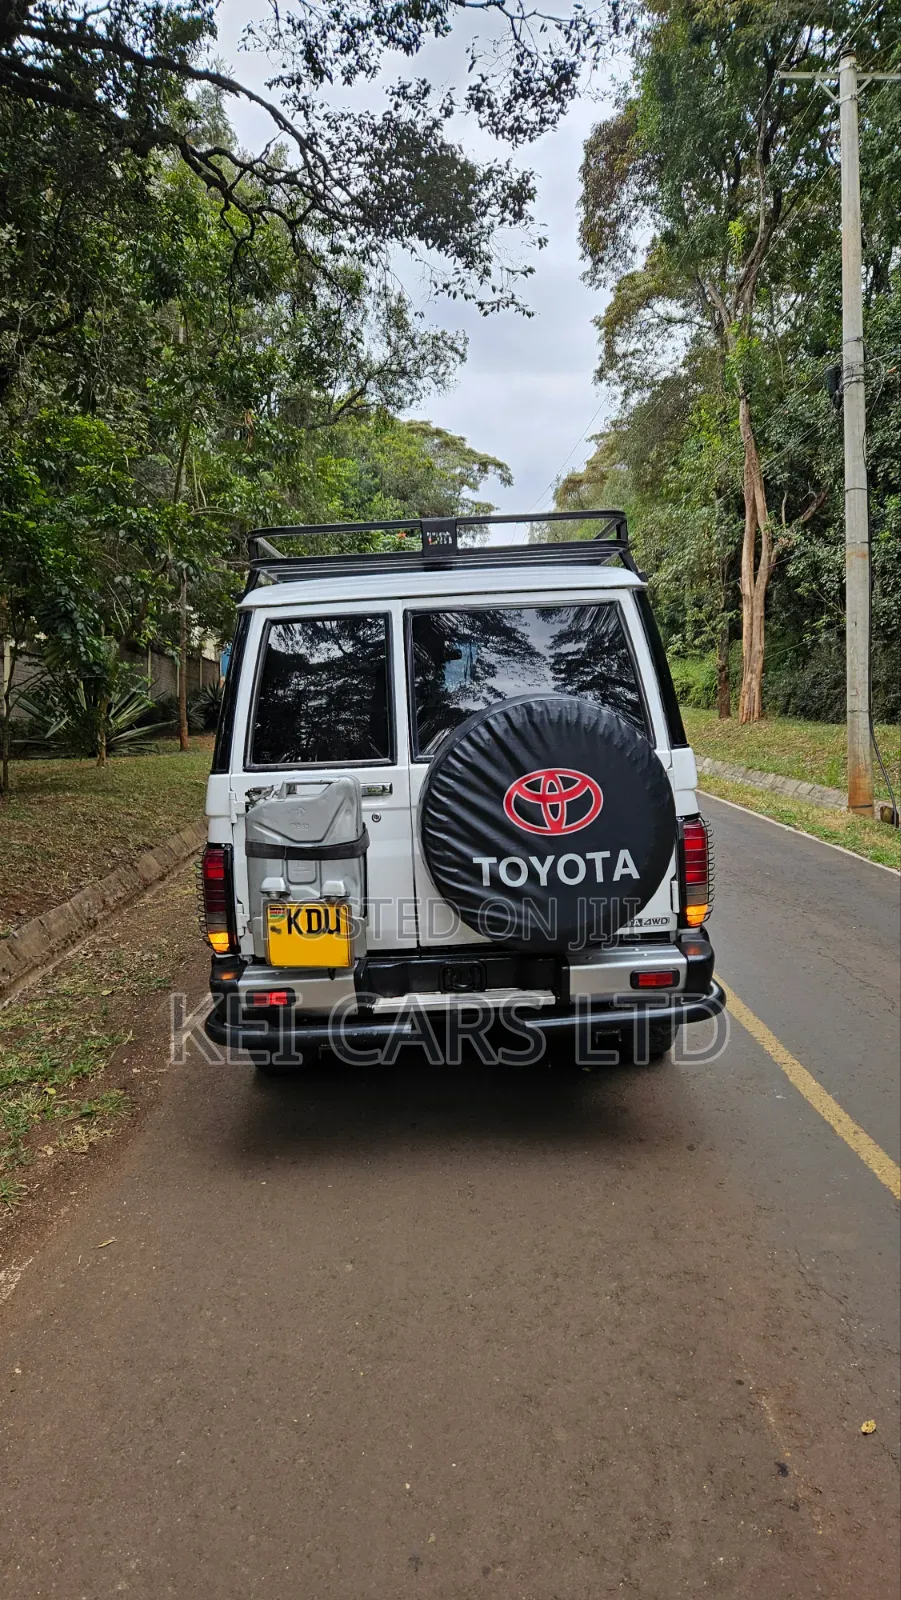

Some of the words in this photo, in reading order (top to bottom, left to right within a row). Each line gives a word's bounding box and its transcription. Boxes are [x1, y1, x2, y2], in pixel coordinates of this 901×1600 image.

[472, 849, 641, 888] TOYOTA
[287, 908, 341, 935] KDU
[643, 917, 670, 926] 4WD
